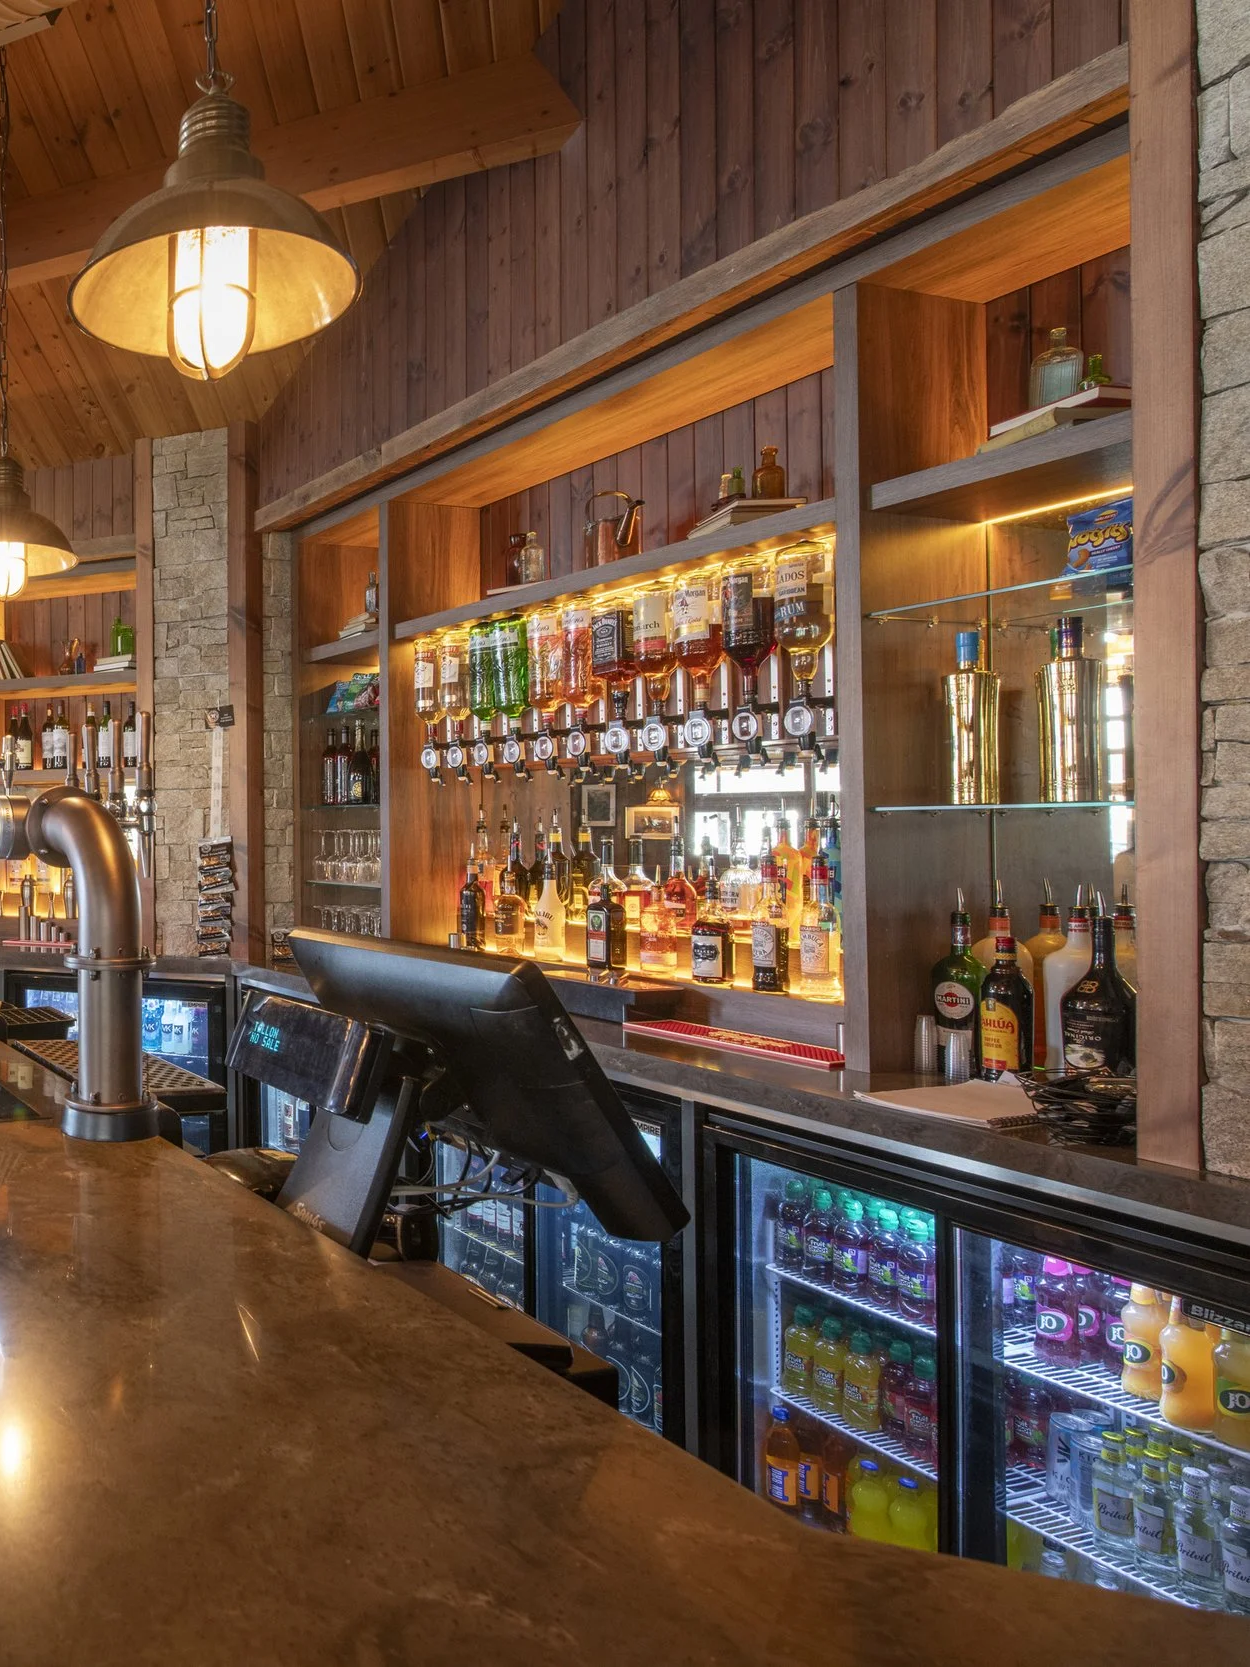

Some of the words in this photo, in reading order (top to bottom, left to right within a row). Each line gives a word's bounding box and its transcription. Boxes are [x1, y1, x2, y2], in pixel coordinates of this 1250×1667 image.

[684, 587, 706, 598] Morgan
[780, 601, 805, 618] RUM
[936, 993, 970, 1005] MARTINI
[145, 1023, 155, 1031] VK
[163, 1024, 172, 1032] VK
[250, 1032, 260, 1044] NO
[261, 1036, 280, 1052] SALE
[1064, 1030, 1102, 1041] ORIGINAL
[636, 1121, 661, 1137] MPIRE
[810, 1240, 825, 1248] Fruit
[1078, 1450, 1100, 1463] KIC
[1052, 1469, 1071, 1485] KIC
[1097, 1502, 1132, 1521] Britvic
[1177, 1541, 1213, 1564] Britvic
